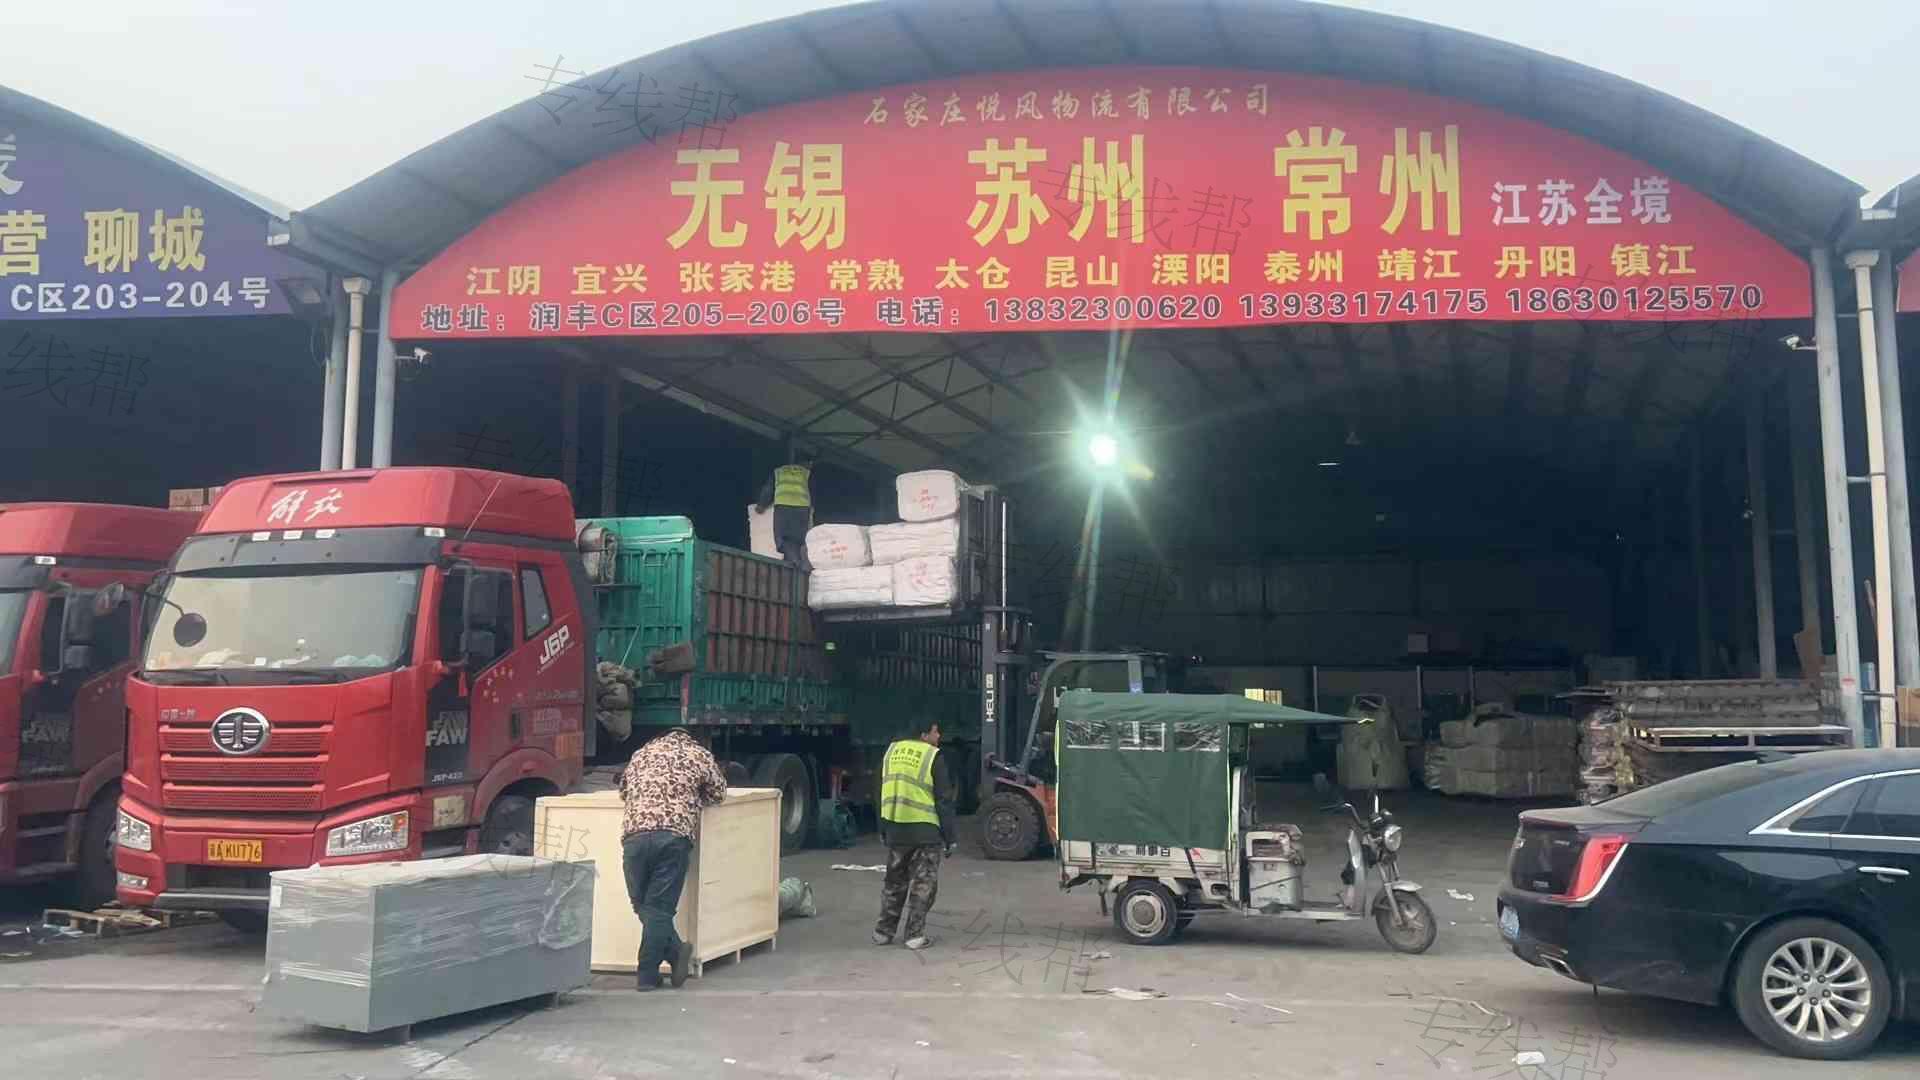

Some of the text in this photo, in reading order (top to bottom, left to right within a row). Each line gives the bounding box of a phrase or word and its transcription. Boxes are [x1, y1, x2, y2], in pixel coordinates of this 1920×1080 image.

[864, 84, 1269, 128] 石家庄悦风物流有限公司
[667, 124, 1673, 250] 无锡 苏州 常州 江苏全境
[83, 206, 207, 274] 聊城
[466, 243, 1697, 297] 江阴 宜兴 张家港 常熟 太仓 昆山 溧阳 泰州 靖江 丹阳 镇江
[10, 275, 272, 315] C区203-204号
[529, 299, 846, 331] 润丰C区205-206号
[984, 295, 1223, 324] 13832300620
[1238, 288, 1489, 319] 13933174175
[1505, 283, 1766, 314] 18630125570
[425, 728, 469, 747] FAW
